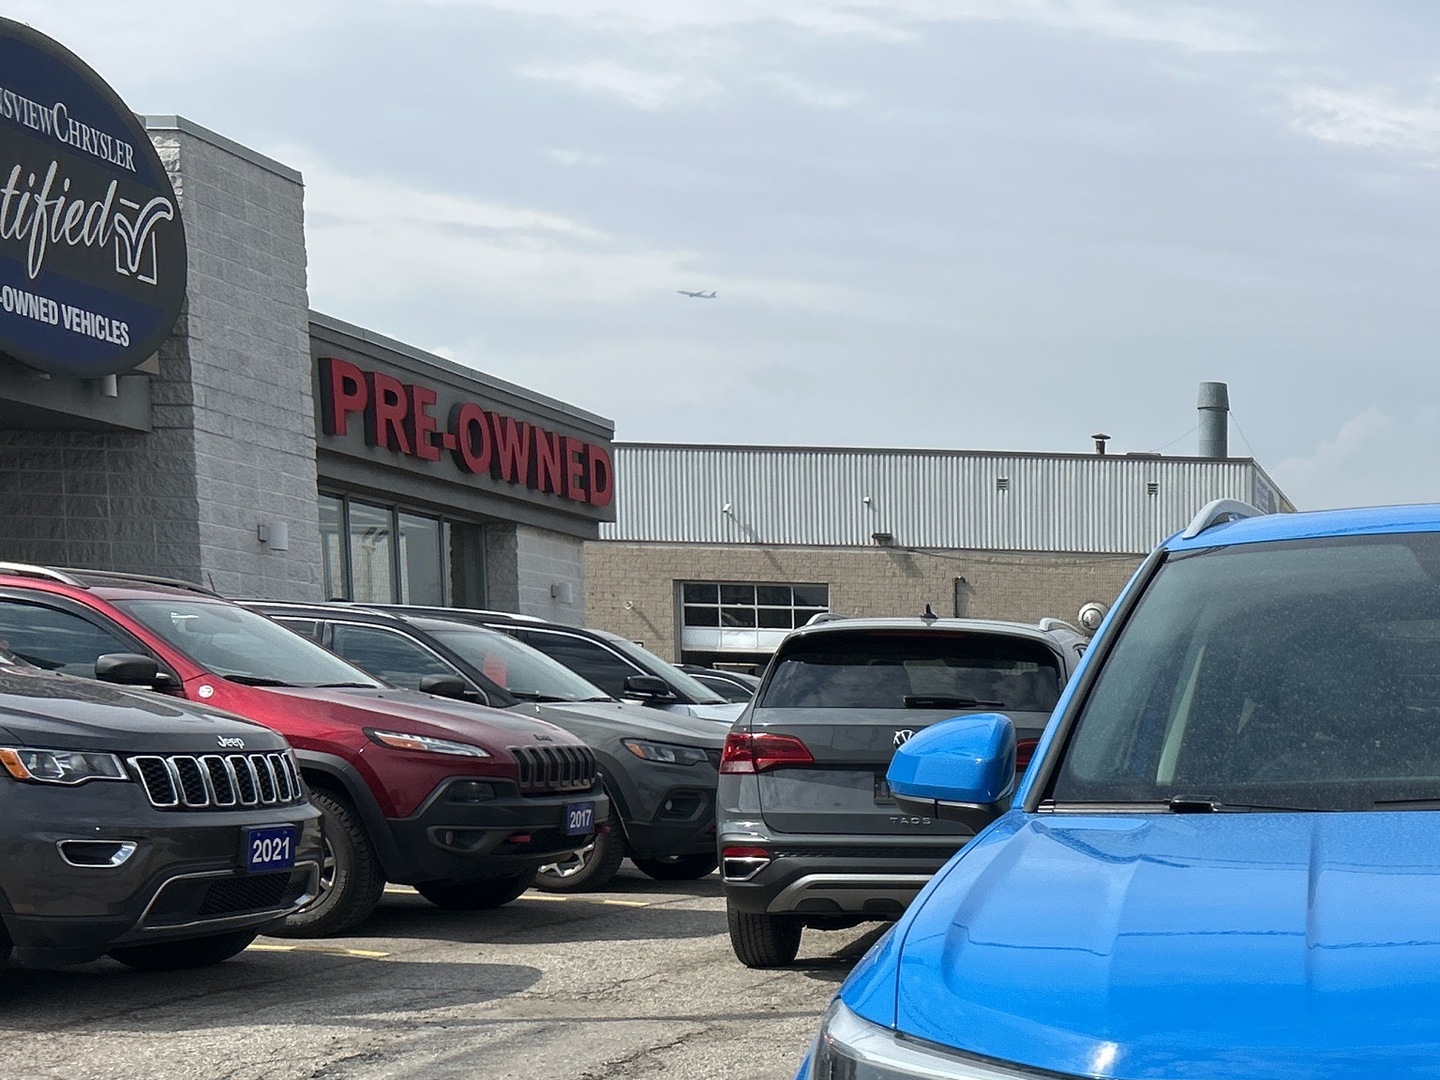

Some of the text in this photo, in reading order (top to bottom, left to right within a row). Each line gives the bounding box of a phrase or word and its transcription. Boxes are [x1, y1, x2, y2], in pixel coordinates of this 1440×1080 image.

[61, 303, 130, 347] VEHICLES
[319, 357, 614, 507] PRE-OWNED
[217, 735, 245, 750] Jeep
[570, 808, 592, 829] 2017
[889, 817, 932, 825] TAOS
[252, 836, 290, 864] 2021
